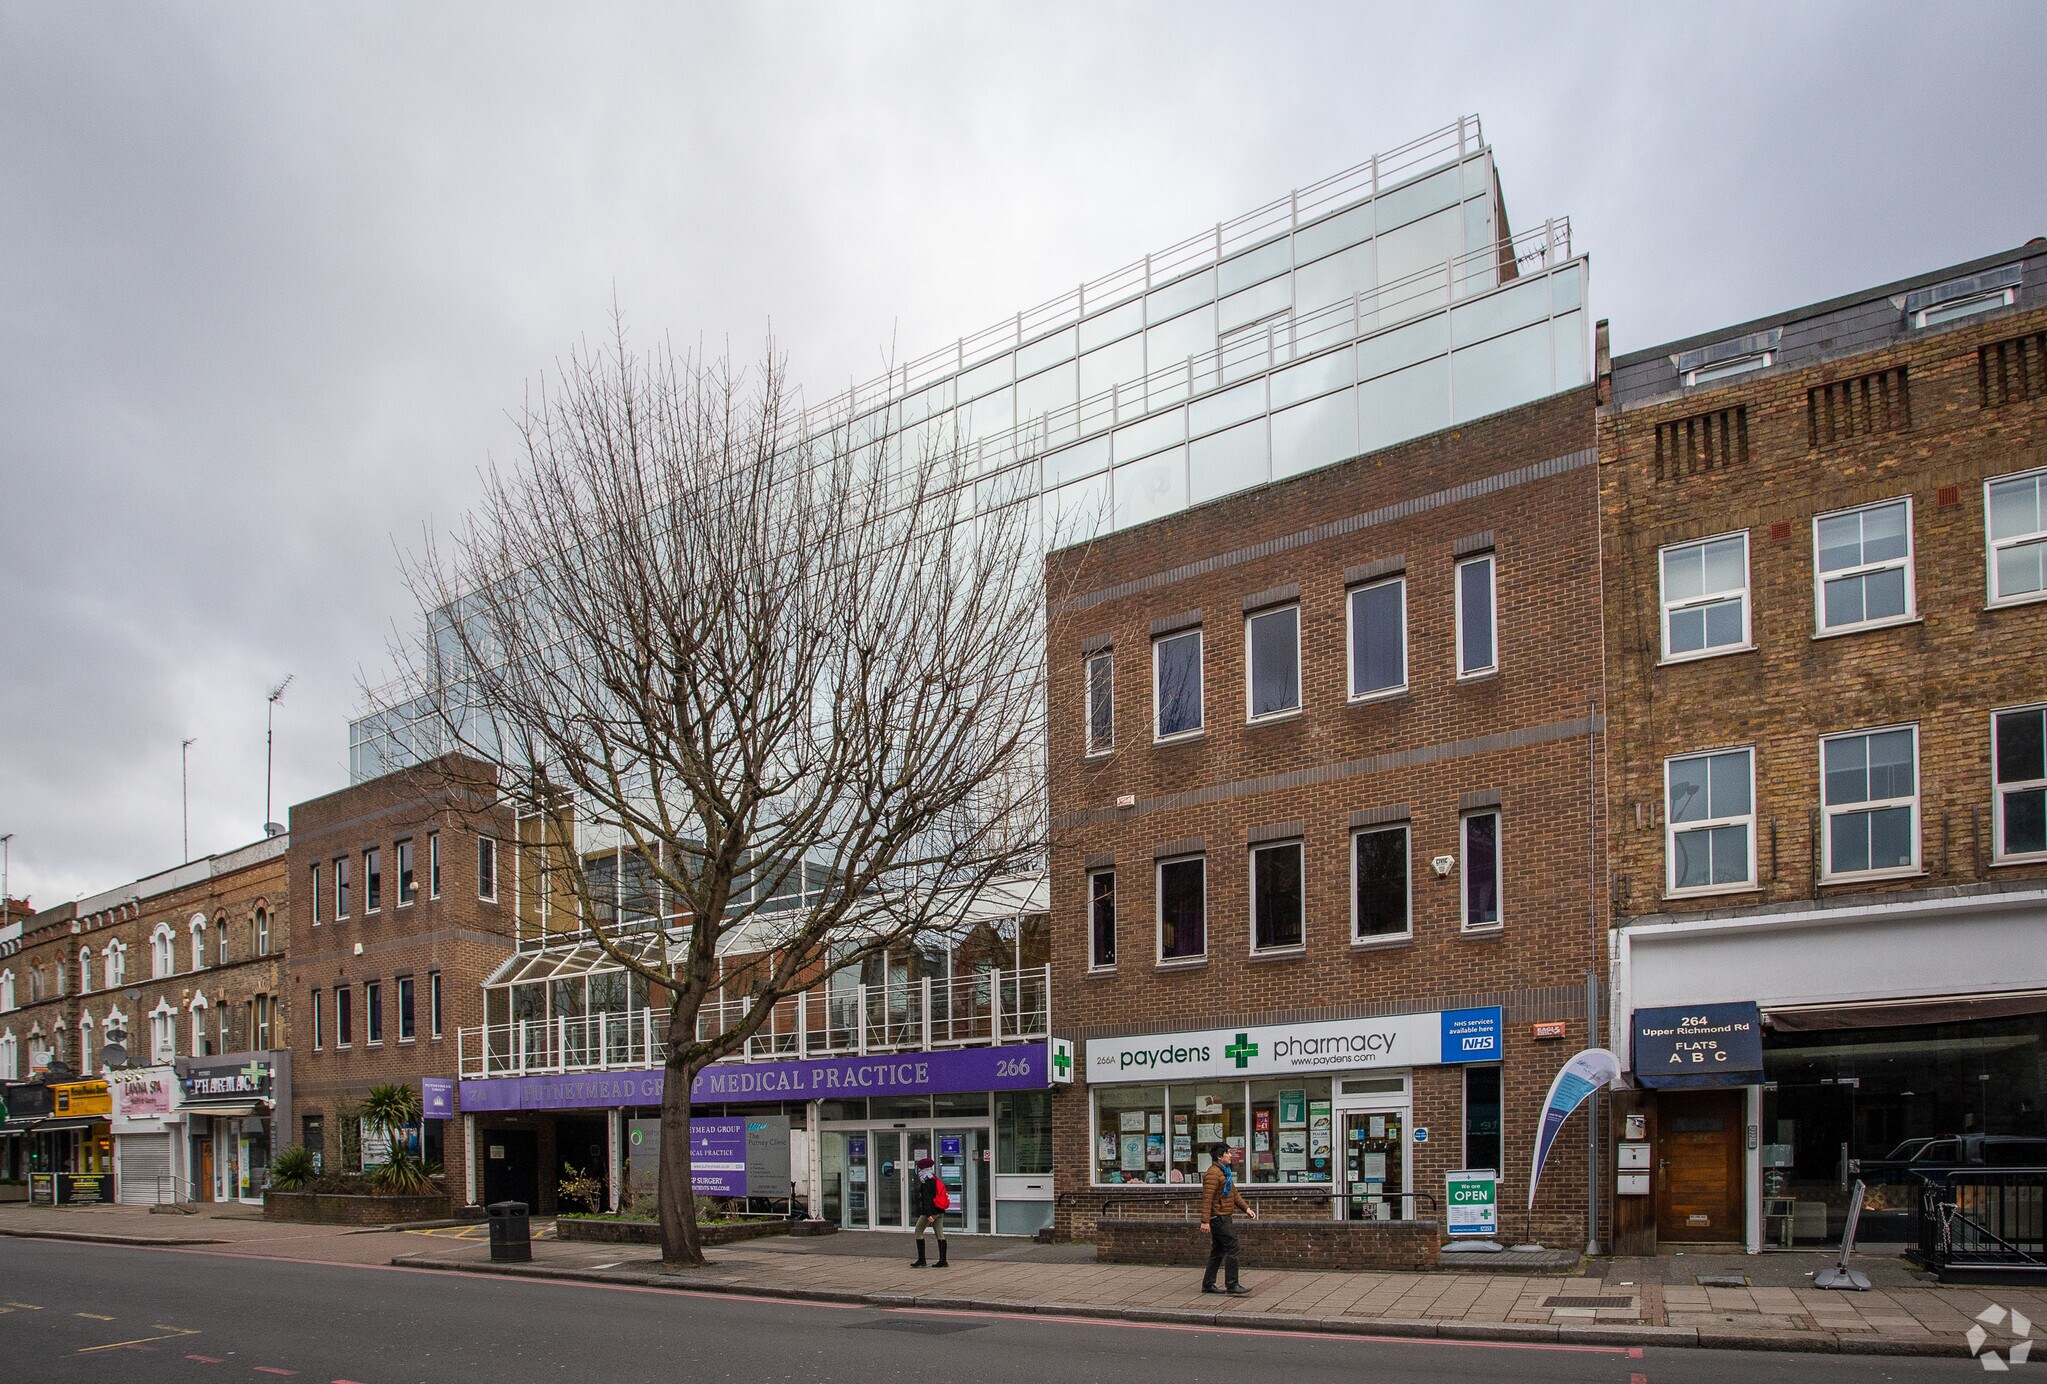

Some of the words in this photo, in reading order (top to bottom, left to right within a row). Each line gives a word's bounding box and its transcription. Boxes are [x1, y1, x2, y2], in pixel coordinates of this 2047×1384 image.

[1468, 1018, 1494, 1026] services
[1681, 1015, 1708, 1027] 264
[1449, 1027, 1478, 1035] available
[1478, 1025, 1494, 1033] here
[1642, 1028, 1674, 1037] Upper
[1677, 1024, 1731, 1035] Richmond
[1734, 1023, 1750, 1031] Rd
[1273, 1032, 1397, 1061] pharmacy
[1463, 1037, 1492, 1050] NHS
[1675, 1041, 1718, 1051] FLATS
[1096, 1055, 1116, 1065] 266A
[1120, 1044, 1211, 1070] paydens
[1669, 1053, 1682, 1063] A
[1692, 1052, 1704, 1063] B
[1714, 1051, 1727, 1062] C
[523, 1080, 636, 1102] PUTNEYMEAD
[641, 1076, 704, 1097] GRP
[710, 1069, 804, 1095] MEDICAL
[812, 1063, 929, 1089] PRACTICE
[996, 1057, 1030, 1077] 266
[717, 1125, 741, 1133] GROUP
[748, 1139, 768, 1148] Putney
[770, 1138, 787, 1146] Clinic
[1454, 1190, 1488, 1201] OPEN
